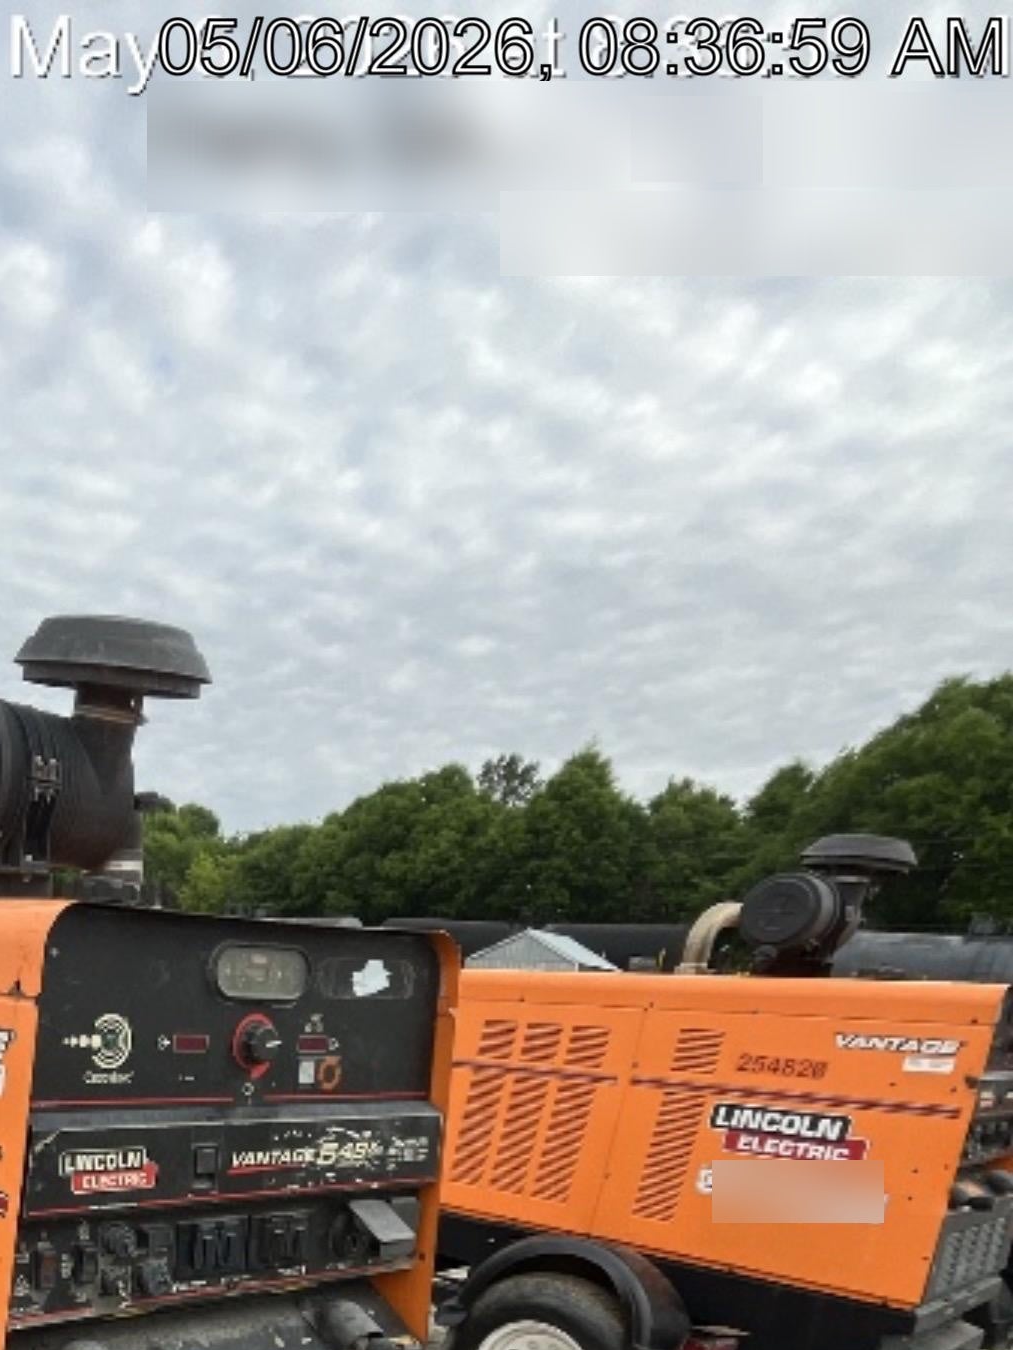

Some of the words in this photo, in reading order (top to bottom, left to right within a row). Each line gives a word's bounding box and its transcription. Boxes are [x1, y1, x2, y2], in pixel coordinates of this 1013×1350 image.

[834, 1032, 961, 1056] VANTAGE
[715, 1105, 843, 1141] LINCOLN
[231, 1147, 317, 1168] VANTAGE
[738, 1135, 850, 1161] ELECTRIC
[64, 1150, 143, 1172] LINCOLN
[81, 1172, 149, 1190] ELECTRIC
